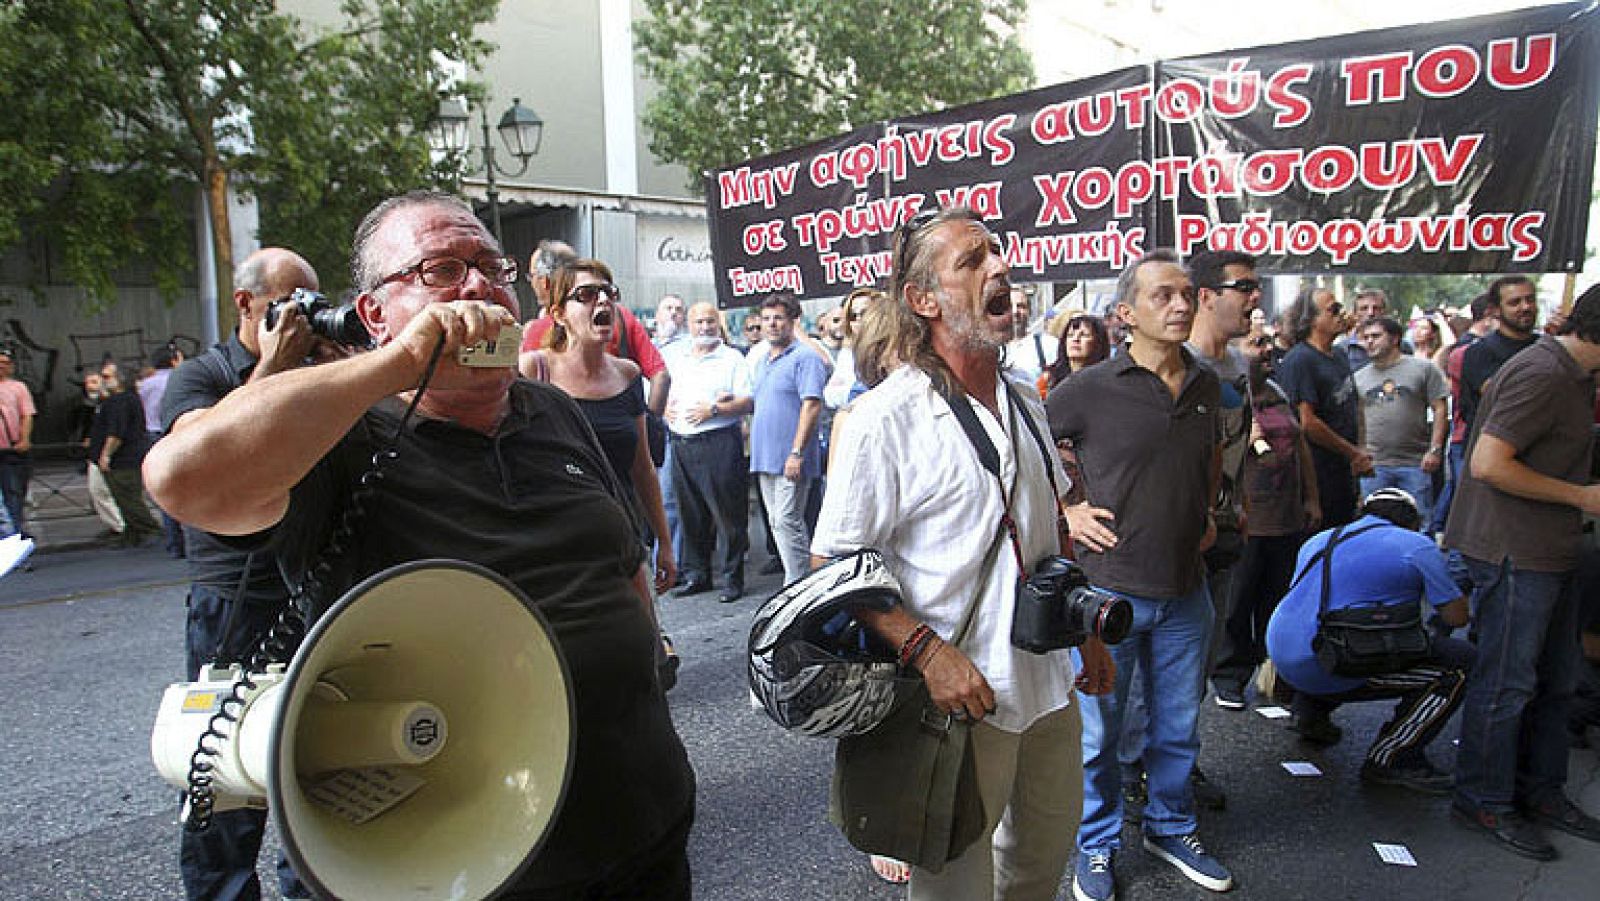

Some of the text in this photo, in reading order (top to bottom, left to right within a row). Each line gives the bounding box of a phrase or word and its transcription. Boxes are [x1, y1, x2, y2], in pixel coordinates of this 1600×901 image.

[718, 33, 1558, 208] Μην αφήνεις αυτούς που
[743, 219, 788, 255] σε
[793, 192, 926, 253] τρώνε
[935, 182, 1003, 220] να
[1033, 133, 1484, 228] χορτάσουν
[1178, 206, 1546, 265] Ραδιοφωνίας
